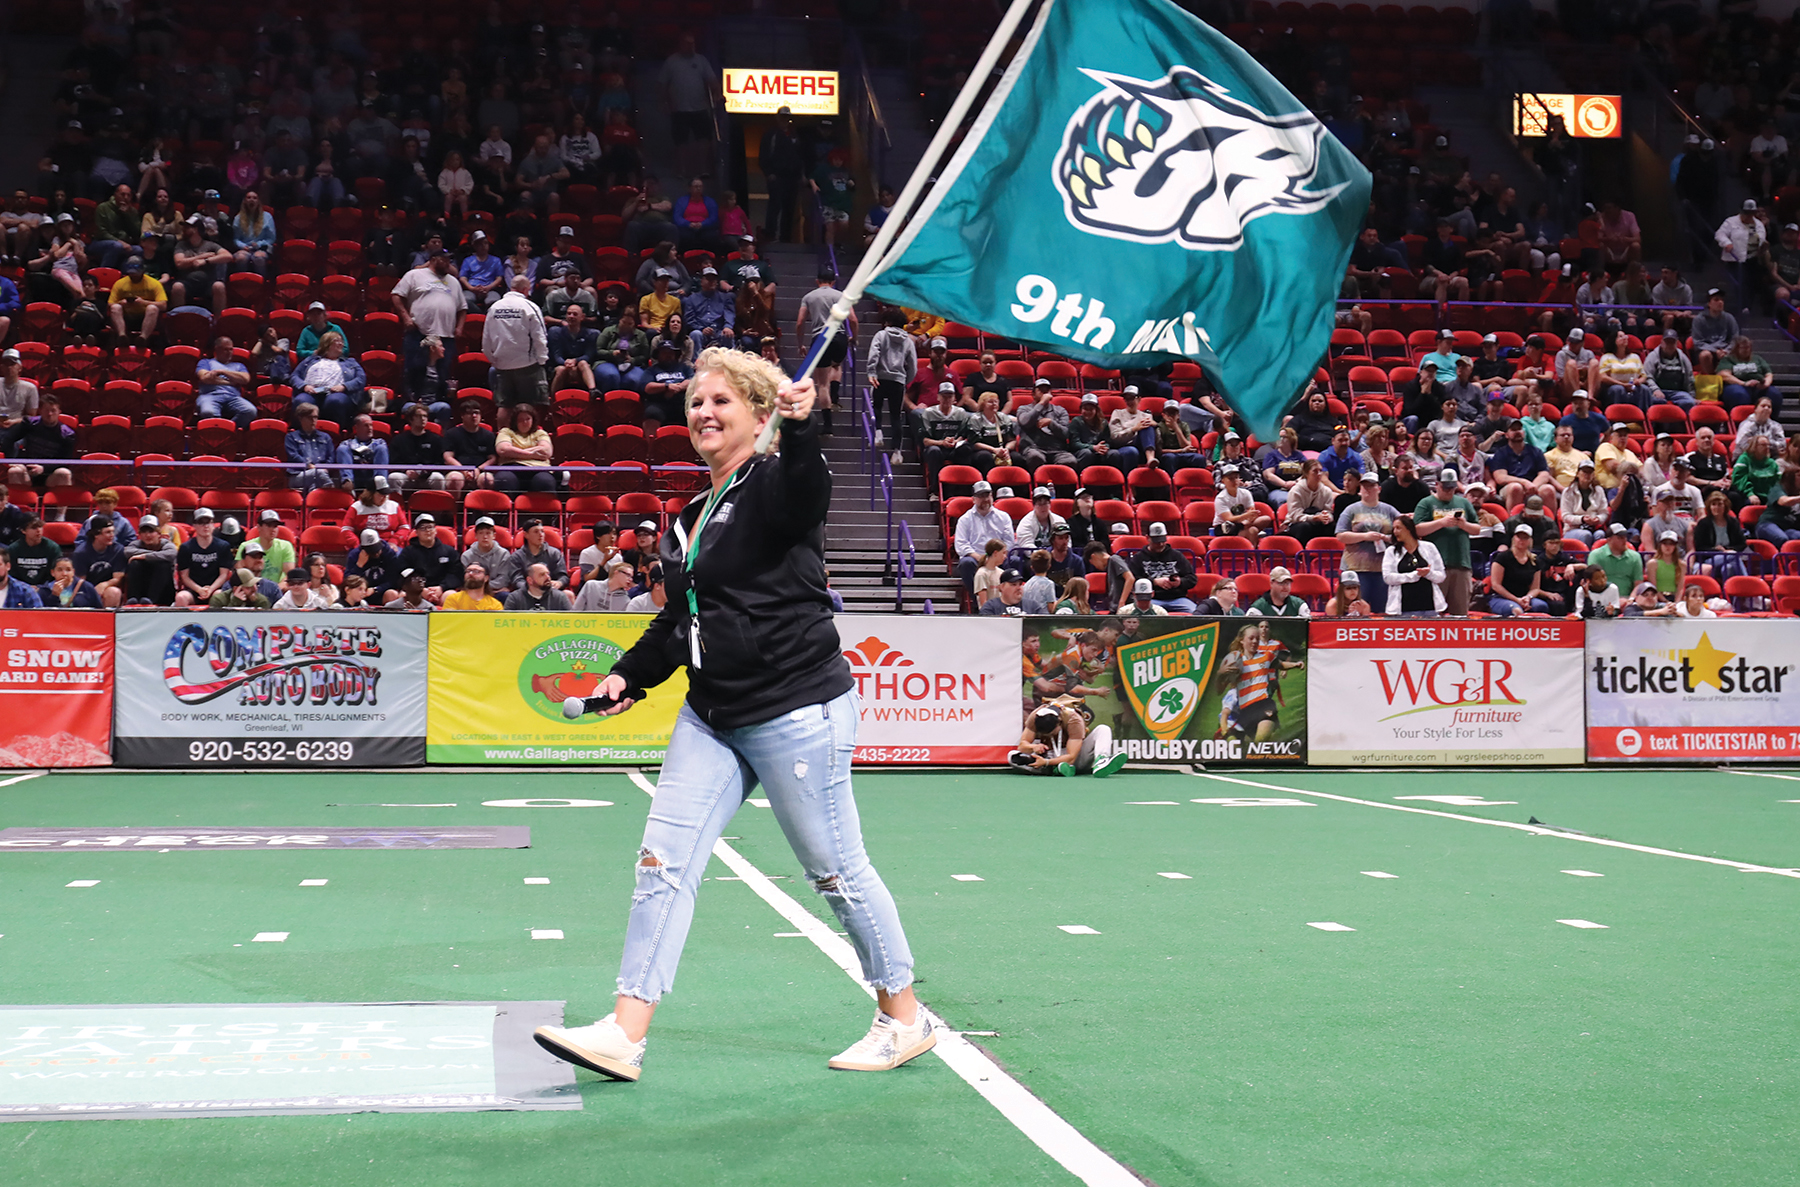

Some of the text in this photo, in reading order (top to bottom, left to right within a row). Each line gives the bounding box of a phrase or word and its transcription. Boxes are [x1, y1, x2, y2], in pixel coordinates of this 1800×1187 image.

[726, 74, 835, 96] LAMERS
[1010, 274, 1116, 349] 9th
[494, 619, 516, 628] EAT
[520, 619, 530, 628] IN
[541, 619, 570, 628] TAKE
[574, 619, 597, 628] OUT
[1336, 628, 1561, 642] BEST SEATS IN THE HOUSE
[535, 639, 624, 660] GALLAGHER'S
[560, 650, 598, 662] PIZZA
[1130, 633, 1208, 662] GREEN BAY YOUTH
[8, 650, 106, 668] SNOW
[163, 622, 383, 705] COMPLETE
[1133, 643, 1206, 688] RUGBY
[42, 672, 105, 683] GAME!
[237, 663, 381, 706] AUTO BODY
[1370, 658, 1522, 706] WG&R
[1592, 656, 1788, 694] ticket star
[161, 714, 386, 723] BODY WORK, MECHANICAL, TIRES/ALIGNMENTS
[874, 708, 974, 722] WYNDHAM
[1449, 708, 1522, 728] furniture
[244, 724, 303, 732] Greenleaf, WI
[1392, 728, 1504, 741] Your Style For Less
[188, 741, 354, 761] 920-532-6239
[1650, 735, 1678, 750] text
[1682, 733, 1766, 750] TICKETSTAR
[1771, 734, 1786, 750] to
[1352, 752, 1544, 762] wgrfurniture.com wgrsleepshop.com
[6, 1020, 398, 1040] IRISH
